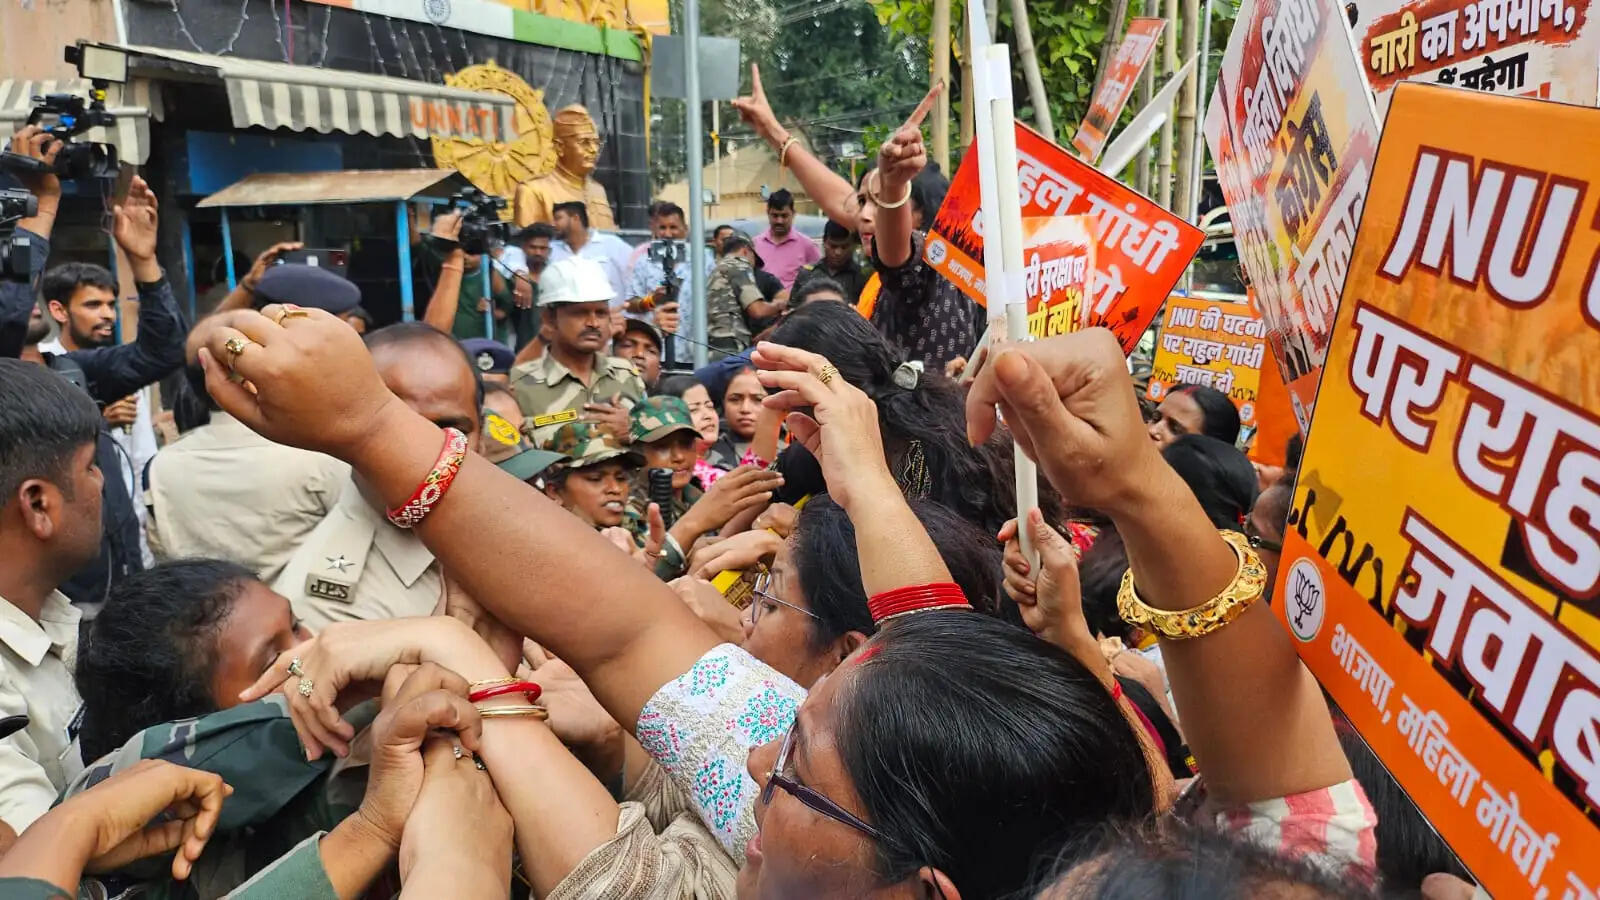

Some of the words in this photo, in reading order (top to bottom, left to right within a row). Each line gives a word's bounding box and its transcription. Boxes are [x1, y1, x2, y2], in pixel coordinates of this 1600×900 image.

[1370, 10, 1419, 76] नारी
[1421, 9, 1459, 63] का
[409, 101, 498, 137] UNNATI
[1086, 193, 1181, 275] गांधी
[1376, 144, 1589, 310] JNU
[1162, 332, 1183, 354] पर
[1183, 337, 1225, 364] राहुल
[1225, 341, 1266, 369] गांधी
[1168, 306, 1198, 329] JNU
[1199, 306, 1222, 333] की
[1222, 313, 1267, 340] घटना
[1214, 368, 1235, 395] दो
[1350, 299, 1466, 453] पर
[1331, 622, 1395, 726] भाजपा,
[1396, 692, 1483, 809] महिला
[1475, 779, 1561, 900] मोर्चा,
